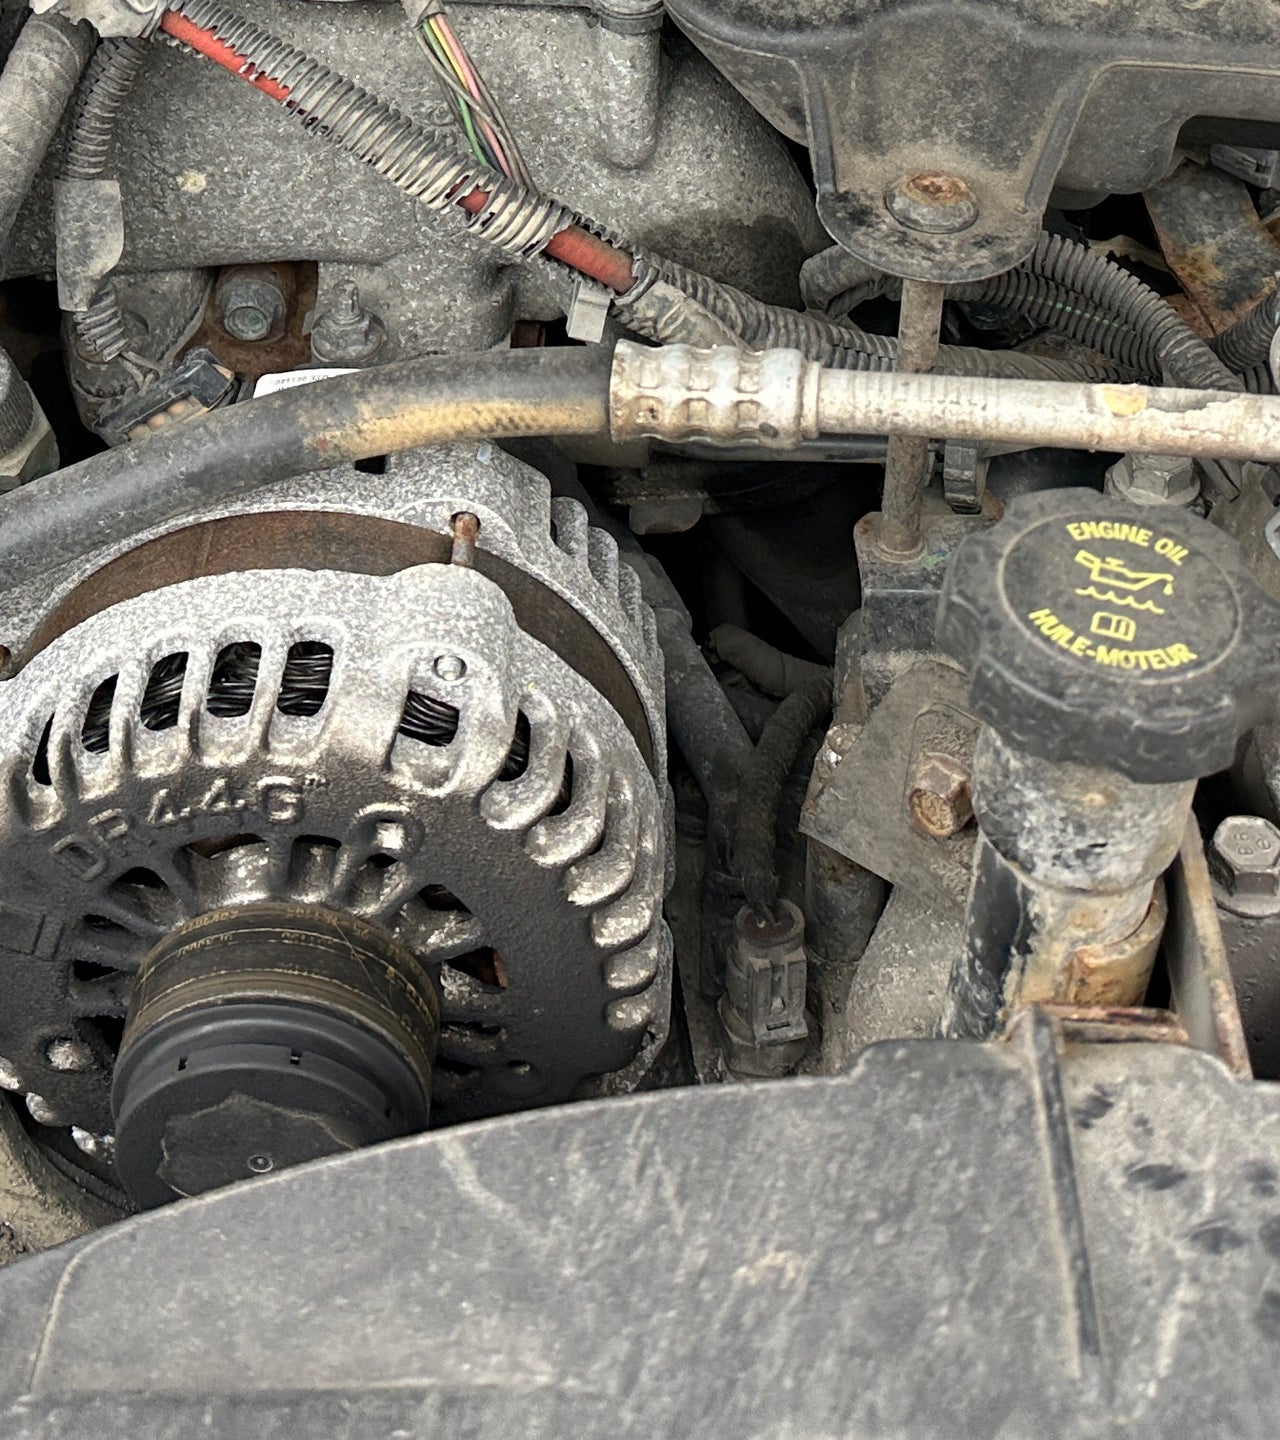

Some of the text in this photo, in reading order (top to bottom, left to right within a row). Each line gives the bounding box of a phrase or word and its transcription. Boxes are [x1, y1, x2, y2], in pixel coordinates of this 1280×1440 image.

[1065, 521, 1190, 566] ENGINE OIL
[1028, 607, 1197, 670] HUILE-MOTEUR
